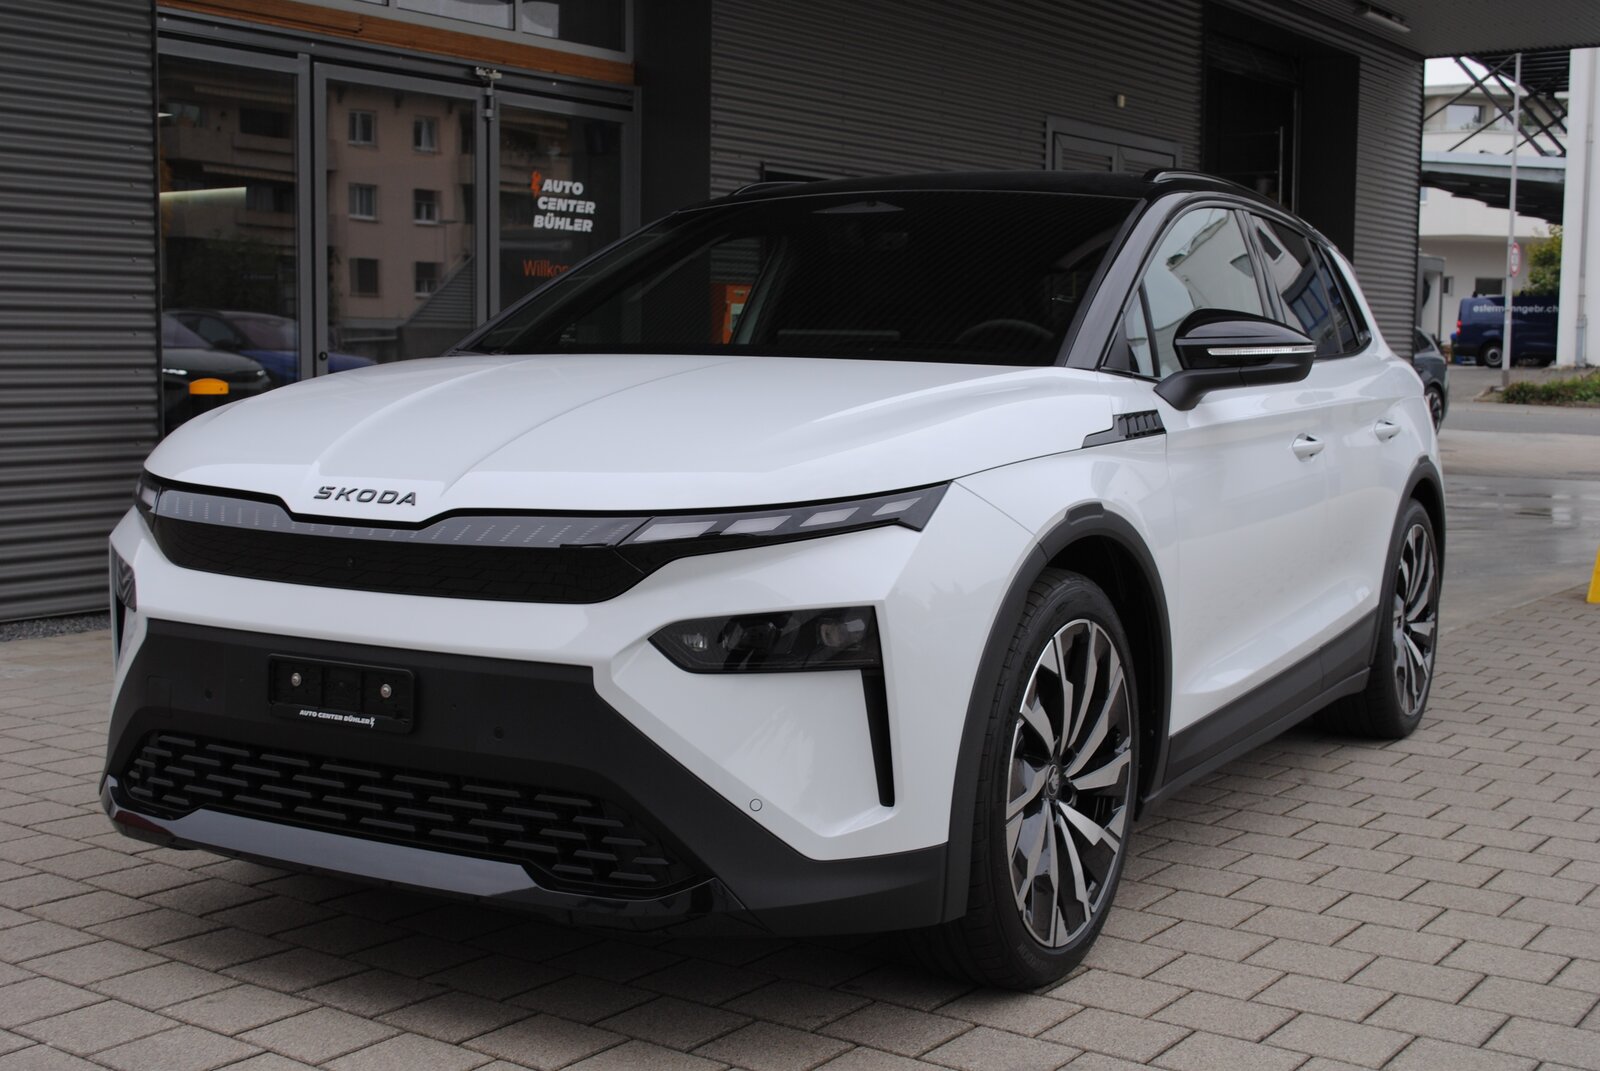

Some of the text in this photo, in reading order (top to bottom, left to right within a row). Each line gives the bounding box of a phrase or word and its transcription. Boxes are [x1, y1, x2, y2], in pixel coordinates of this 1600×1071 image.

[541, 179, 584, 195] AUTO
[537, 196, 596, 214] CENTER
[533, 212, 593, 232] BÜHLER
[1472, 304, 1560, 315] estermnngebr.ch
[299, 709, 370, 725] AUTO CENTER BÜHLER
